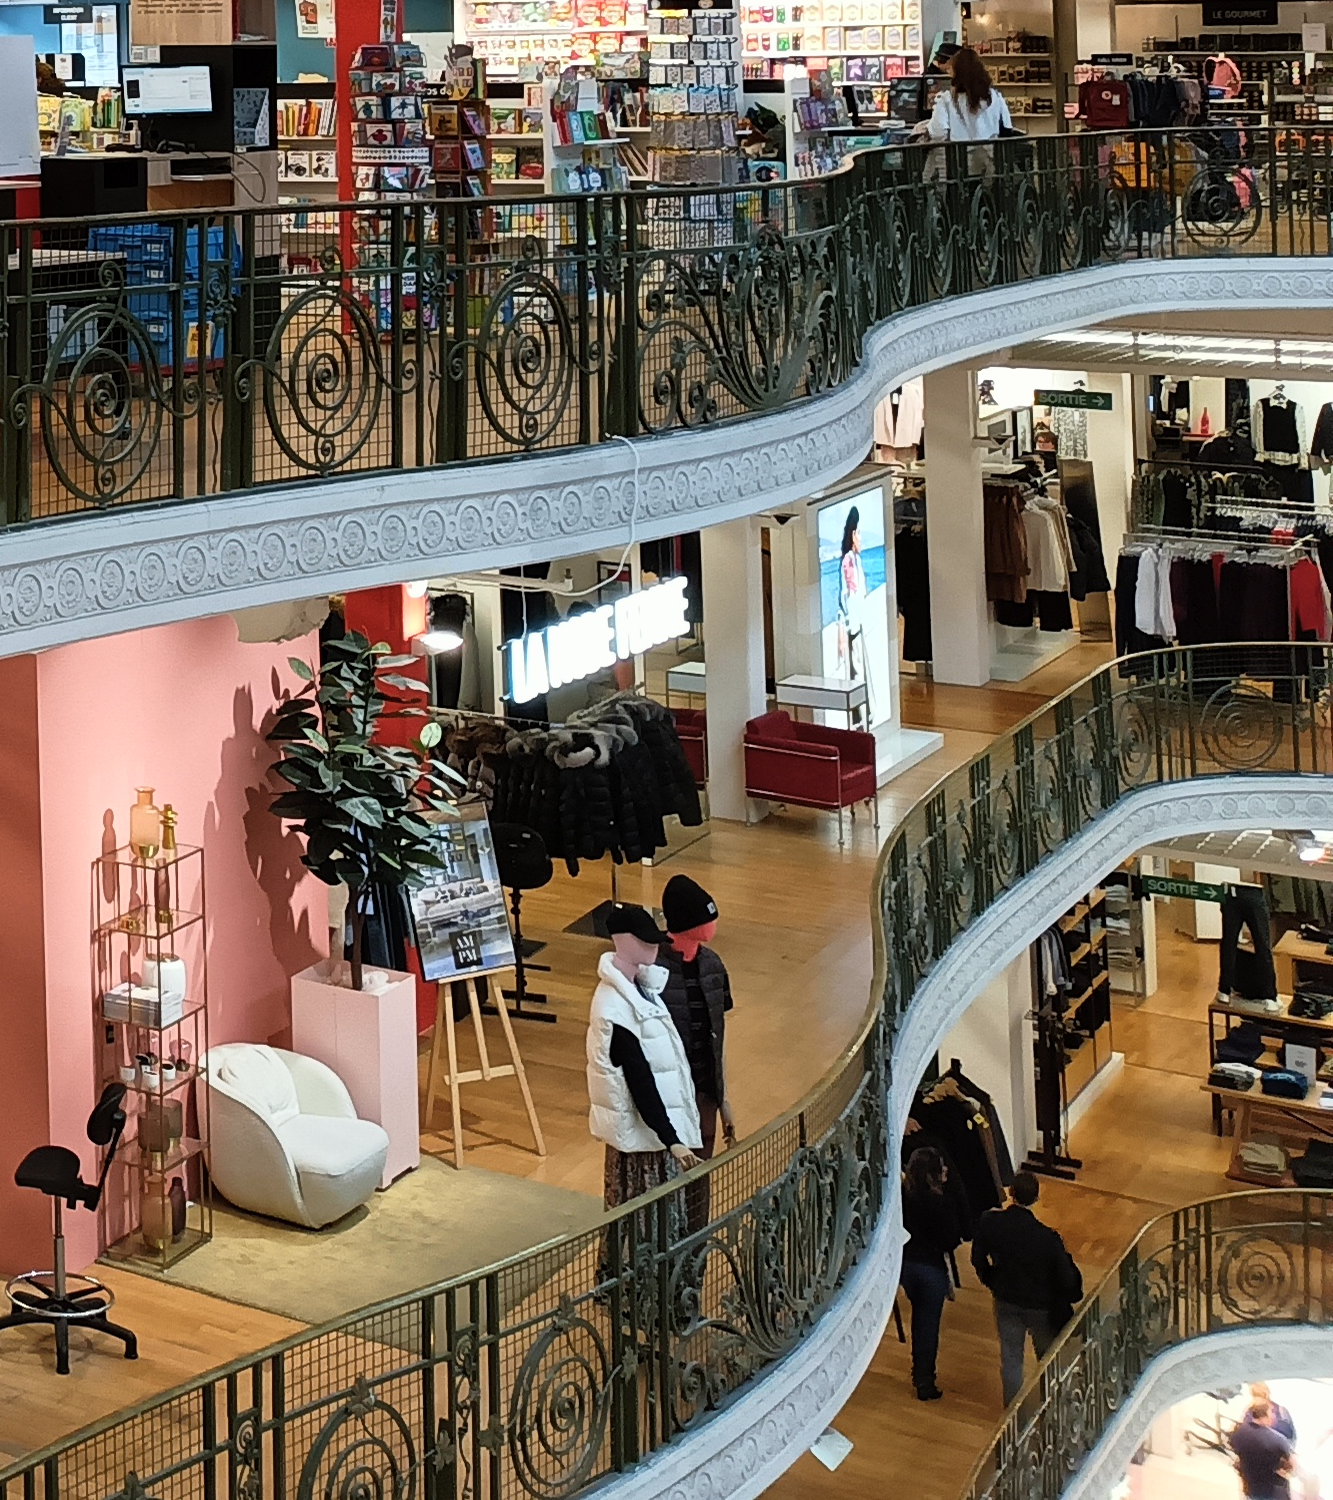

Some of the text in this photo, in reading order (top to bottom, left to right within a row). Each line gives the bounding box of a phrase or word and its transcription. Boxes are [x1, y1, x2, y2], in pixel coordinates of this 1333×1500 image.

[1212, 9, 1268, 20] LE GOURMET
[1038, 392, 1087, 406] SORTIE
[1147, 879, 1199, 897] SORTIE
